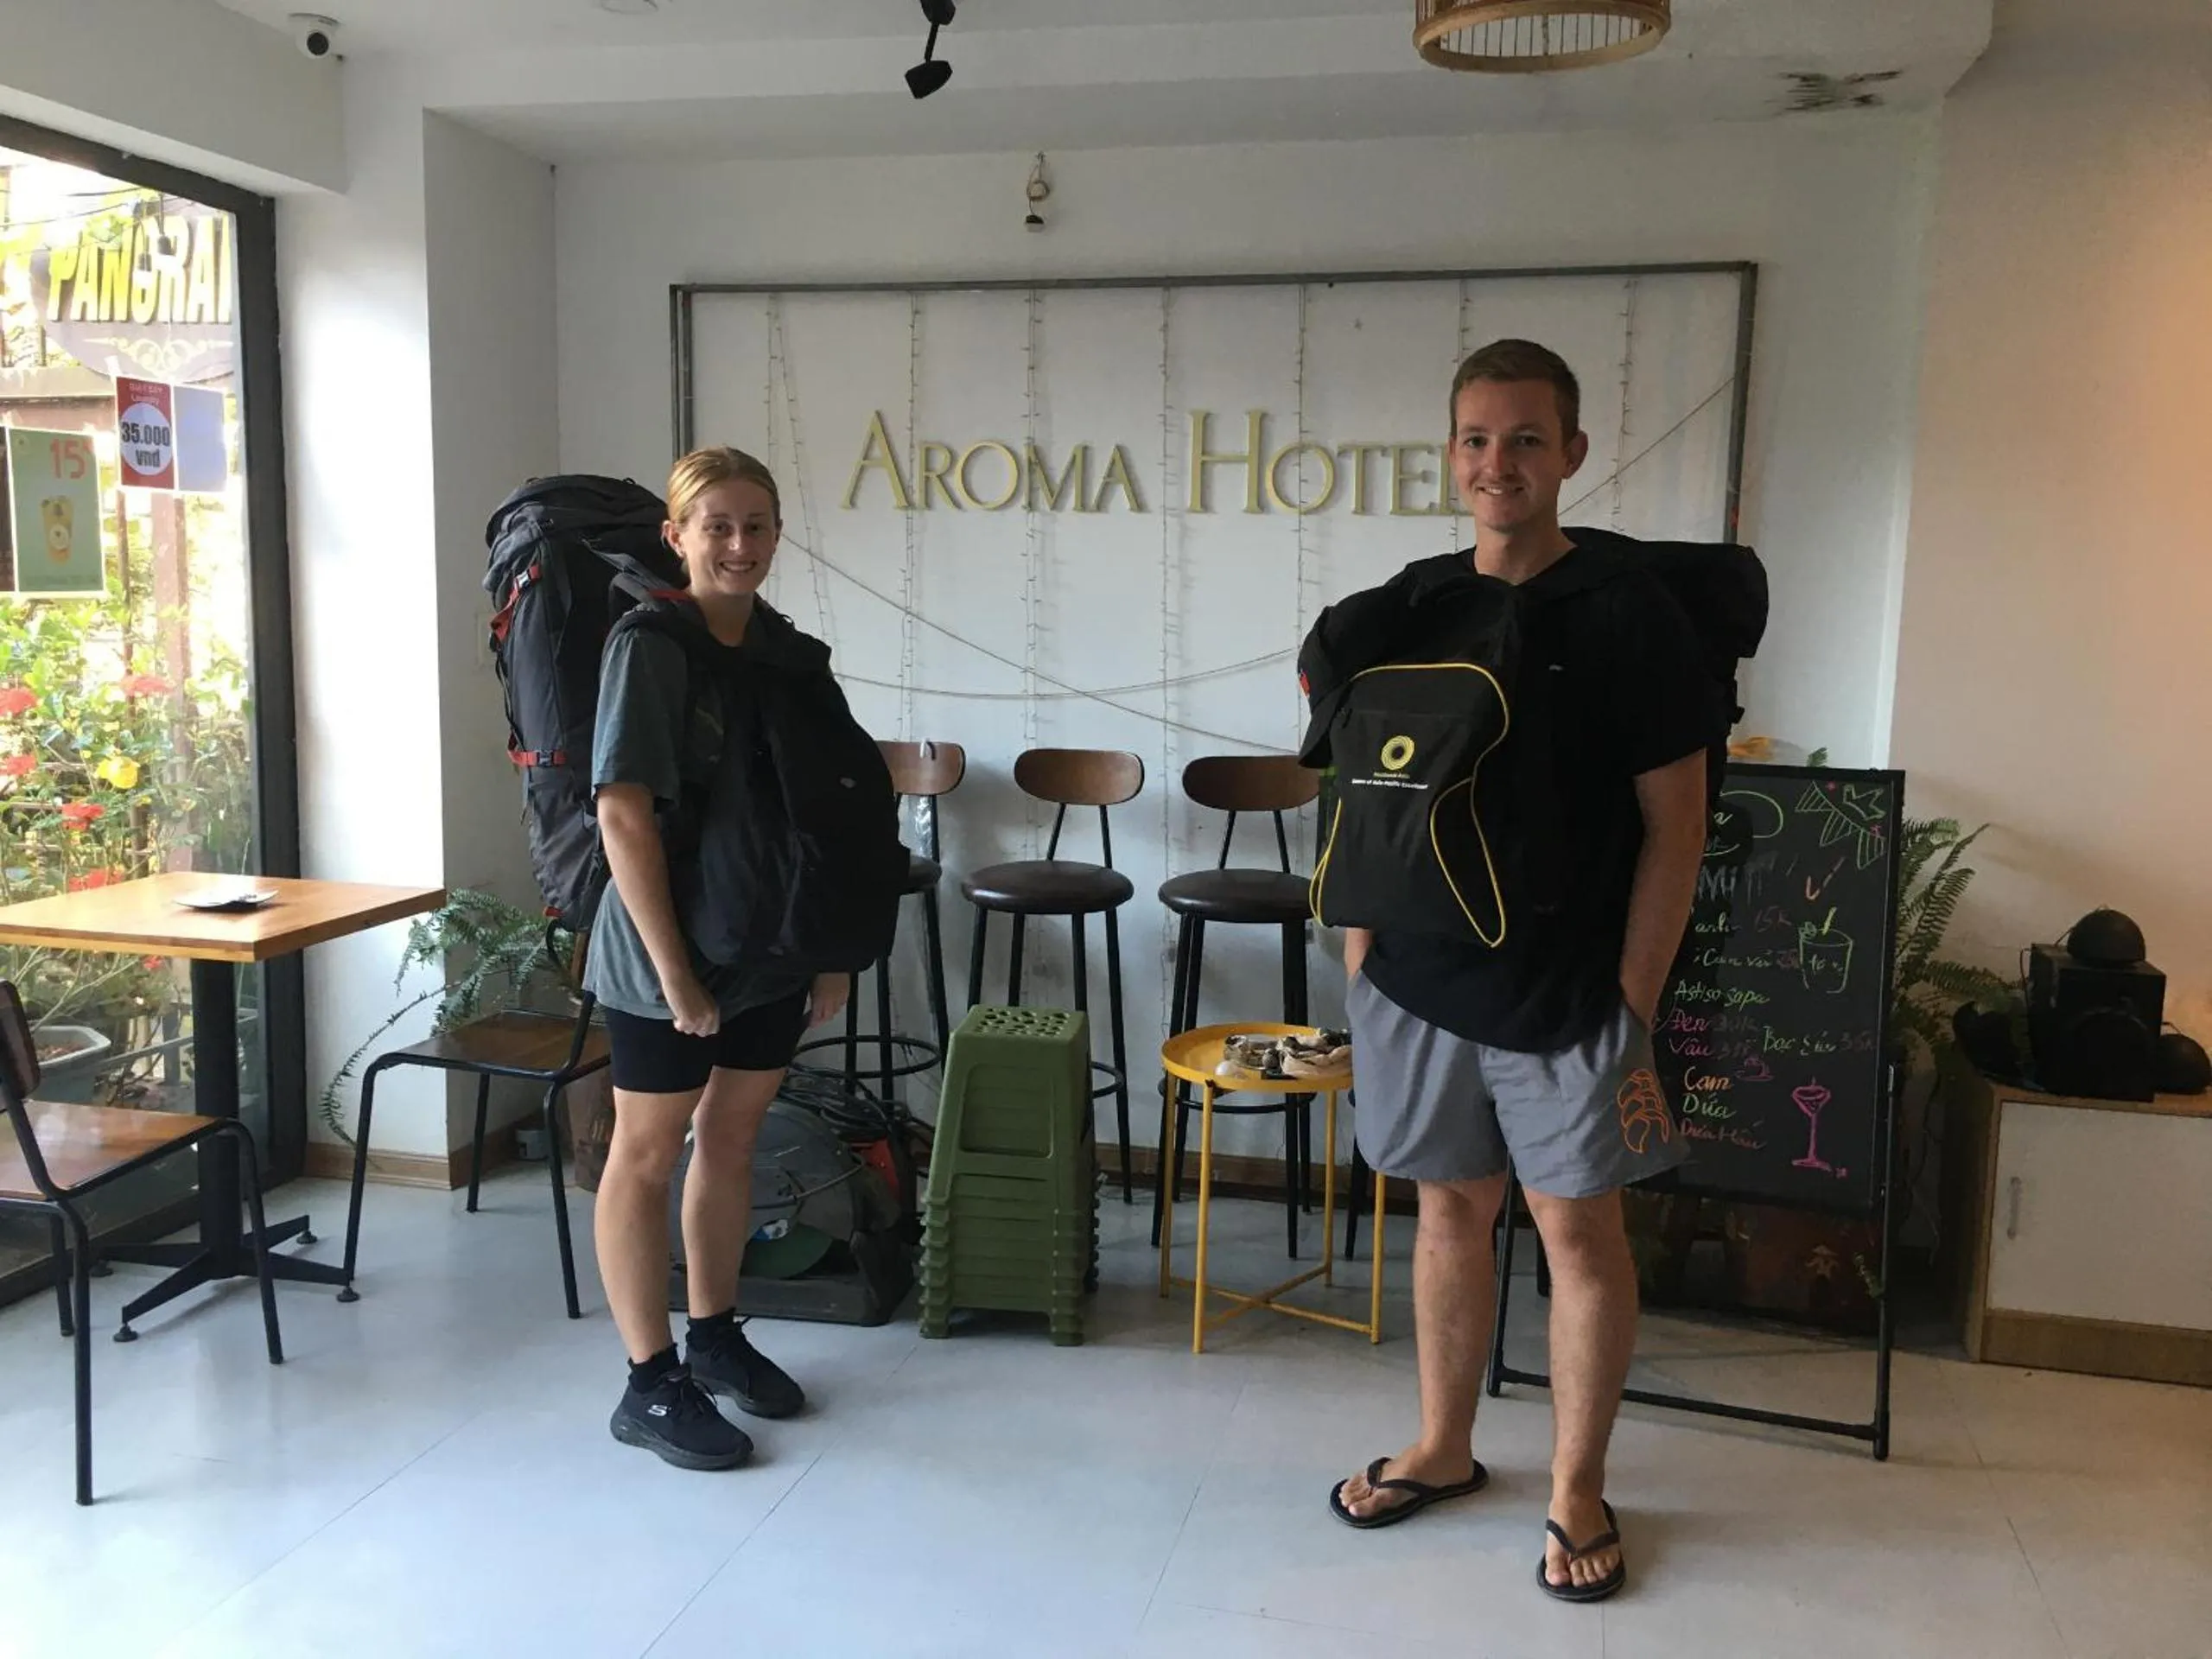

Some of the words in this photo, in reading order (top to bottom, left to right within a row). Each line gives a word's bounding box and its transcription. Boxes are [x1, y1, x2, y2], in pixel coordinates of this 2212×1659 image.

[121, 421, 171, 447] 35.000
[135, 448, 161, 467] vnd
[840, 410, 1149, 512] AROMA
